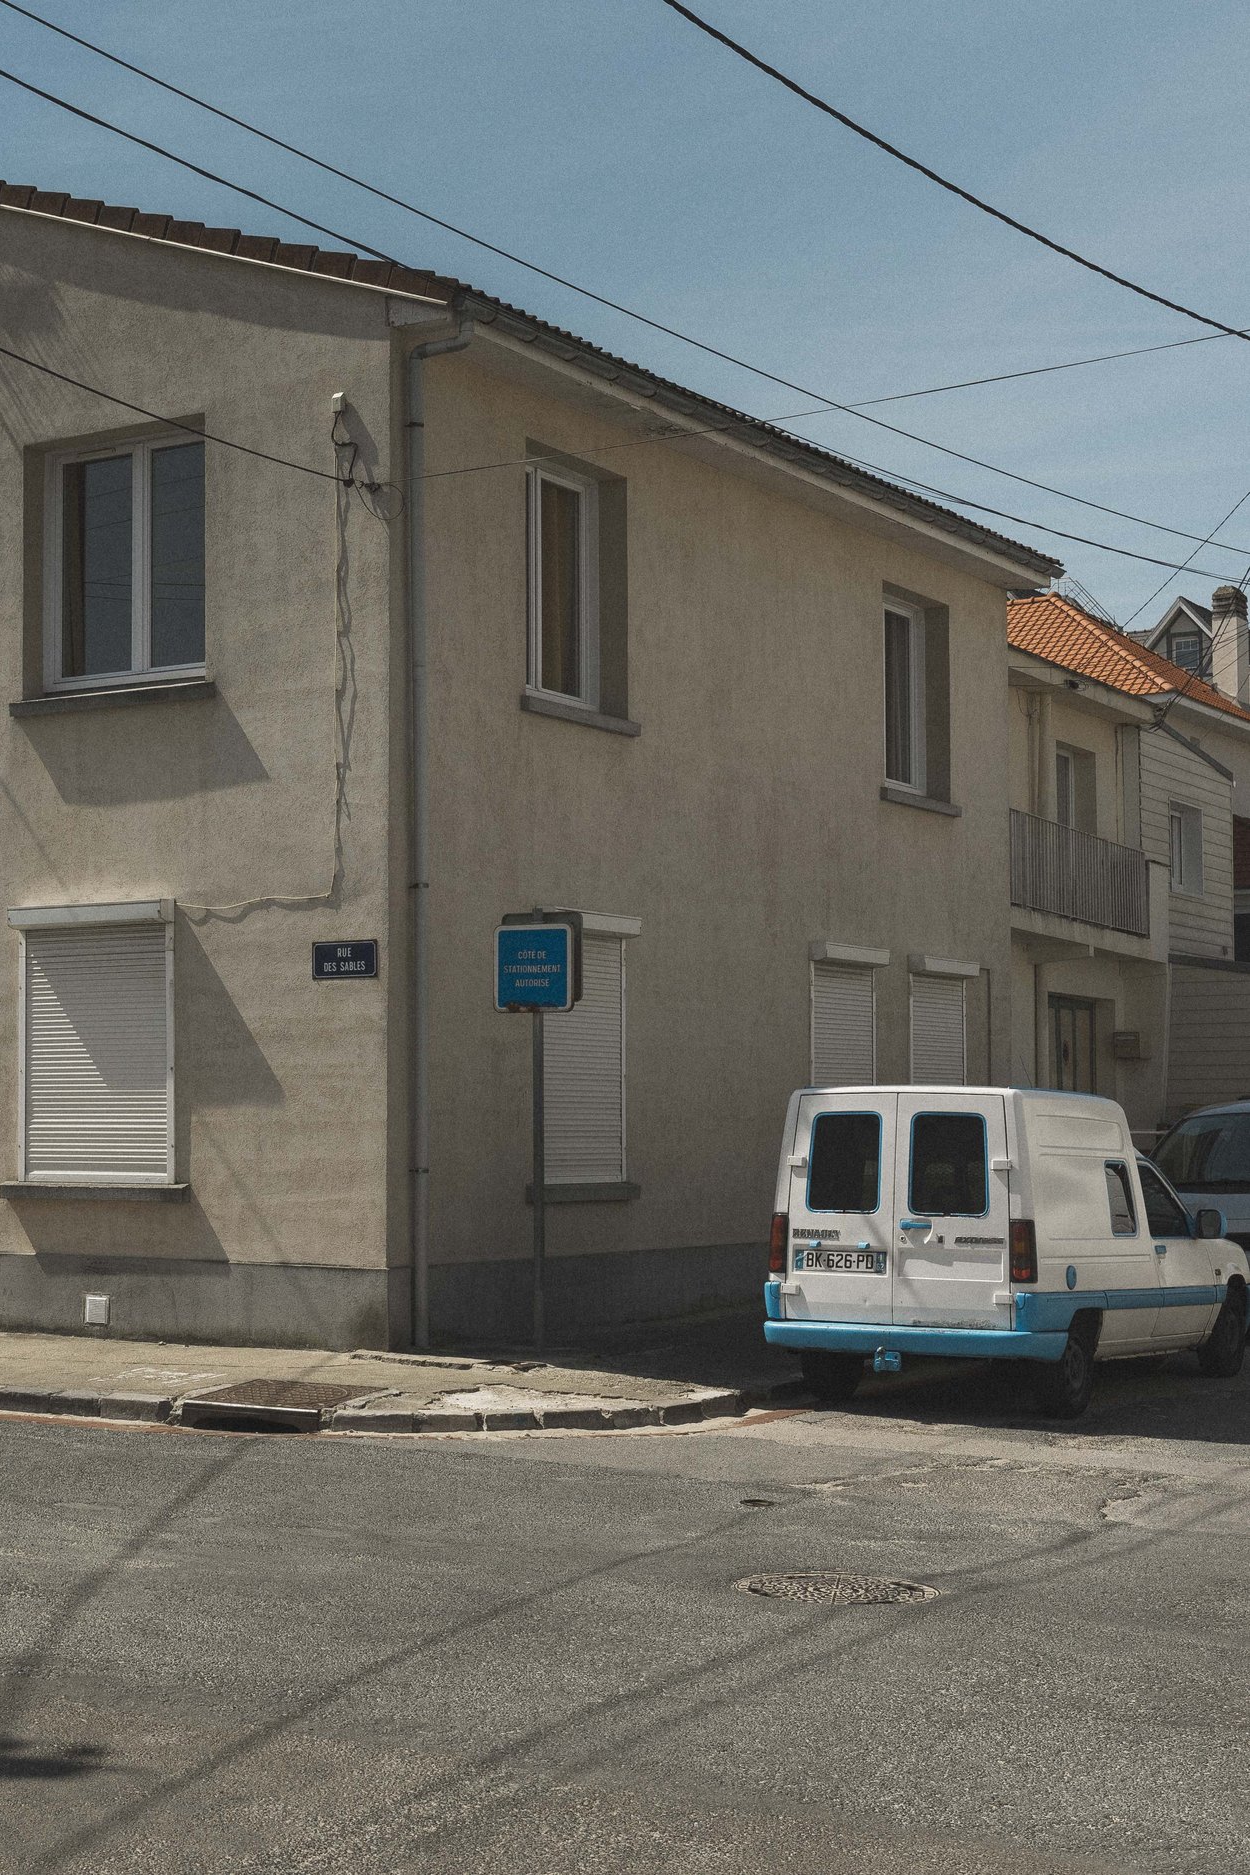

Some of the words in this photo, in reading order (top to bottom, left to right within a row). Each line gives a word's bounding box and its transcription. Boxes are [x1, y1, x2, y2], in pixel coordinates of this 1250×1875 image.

[337, 947, 352, 958] RUE
[537, 950, 547, 960] DE
[323, 962, 337, 972] DES
[340, 960, 366, 971] SABLES
[503, 964, 561, 974] STATIONNEMENT
[792, 1228, 840, 1240] RENAULT
